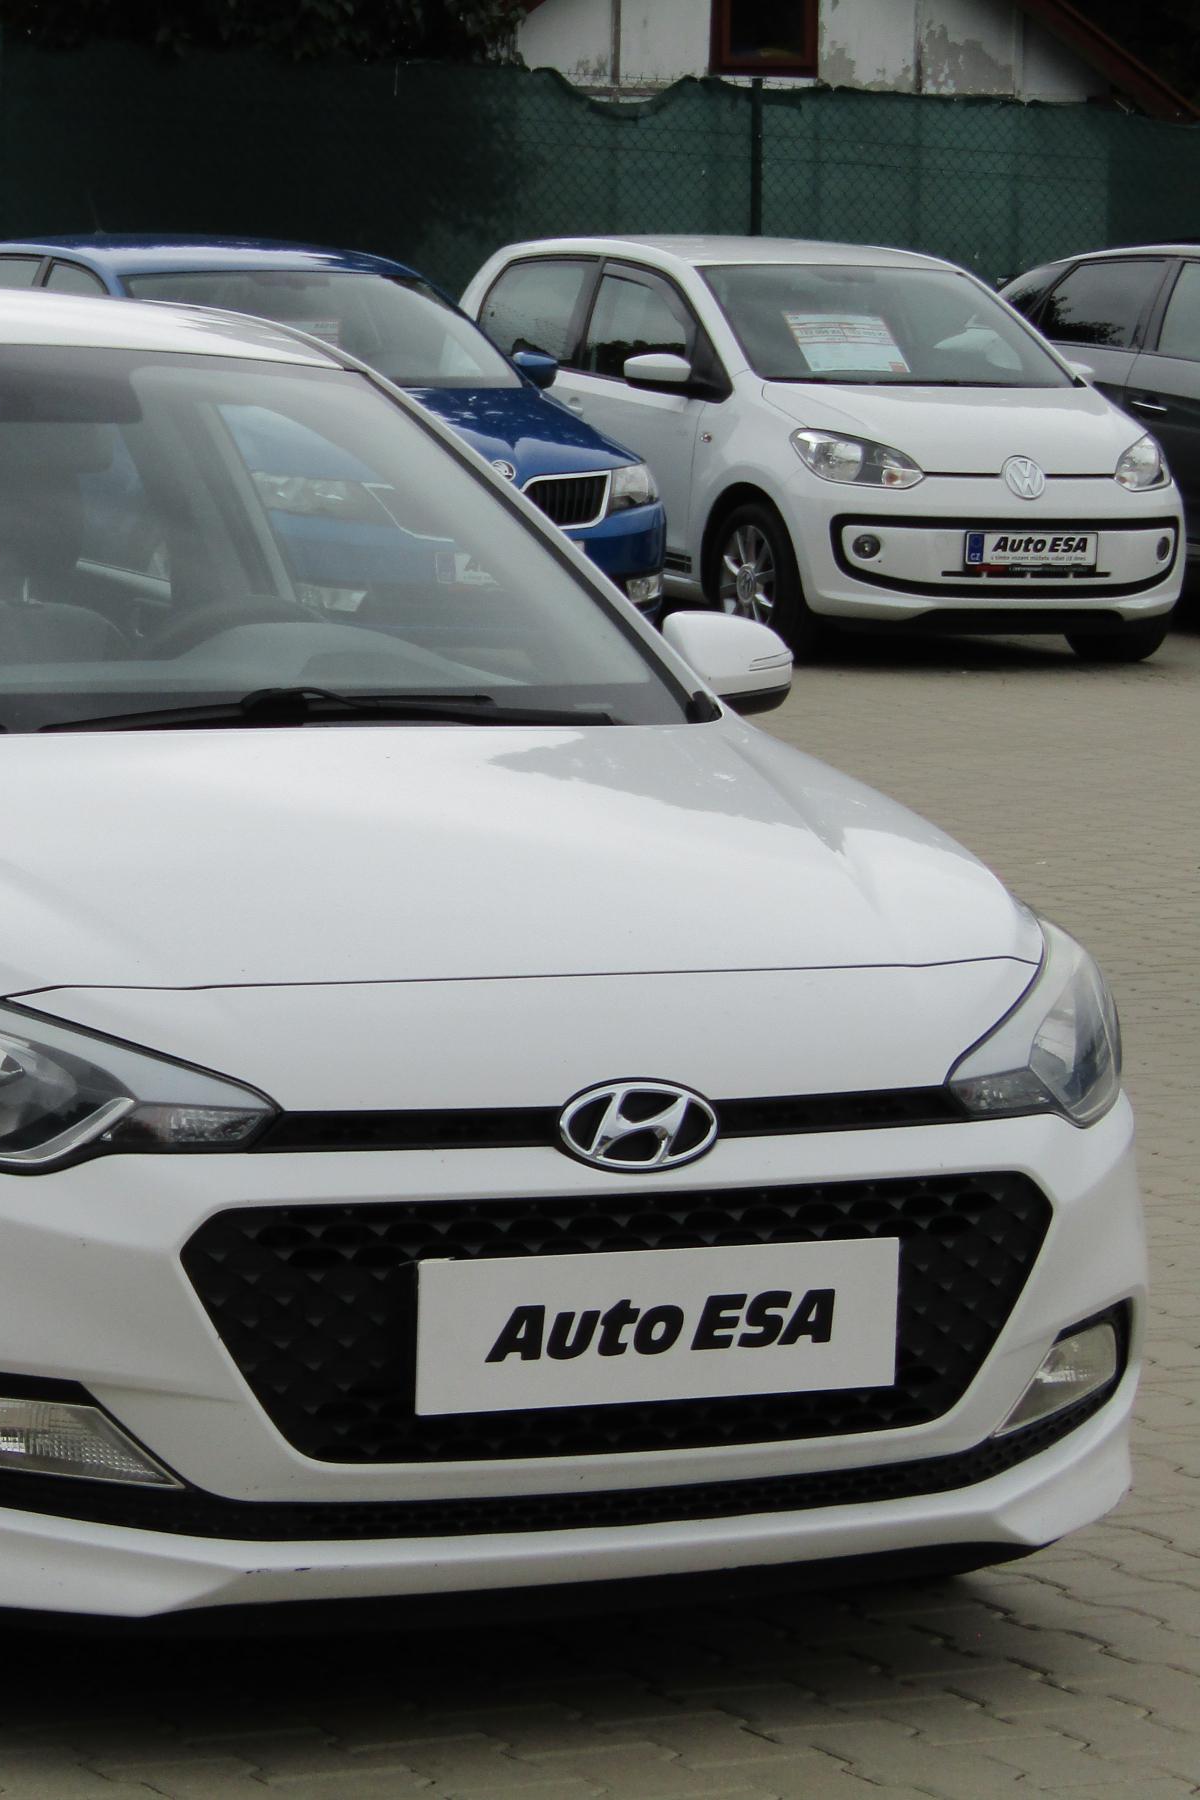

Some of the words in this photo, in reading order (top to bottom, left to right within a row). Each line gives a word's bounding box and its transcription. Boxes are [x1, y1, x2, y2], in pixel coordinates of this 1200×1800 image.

[992, 536, 1047, 553] Auto
[1048, 537, 1088, 553] ESA
[970, 552, 981, 561] CZ
[484, 1299, 685, 1364] Auto
[690, 1288, 836, 1352] ESA
